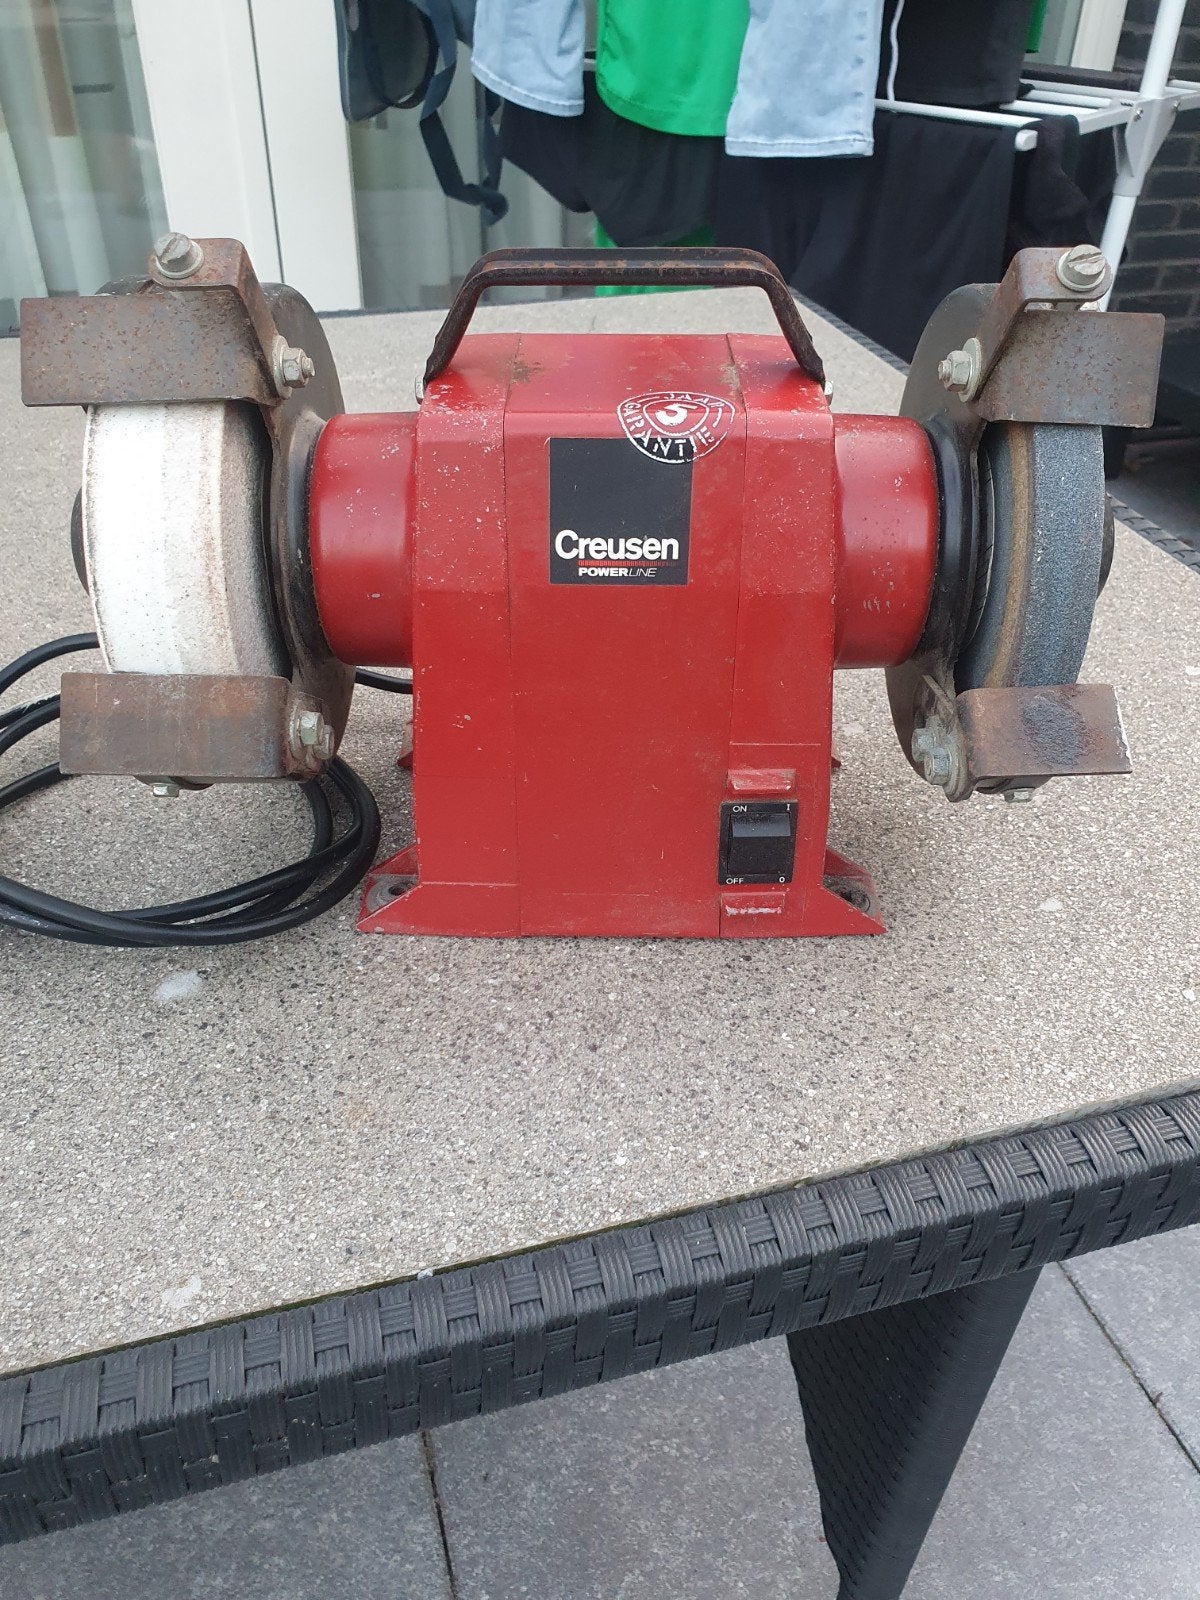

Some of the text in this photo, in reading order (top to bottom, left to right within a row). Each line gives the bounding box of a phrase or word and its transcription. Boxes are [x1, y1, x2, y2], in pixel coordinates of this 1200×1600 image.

[655, 402, 698, 427] 5
[554, 528, 680, 560] Creusen
[578, 567, 658, 578] POWERLINE
[732, 805, 748, 813] ON
[725, 877, 744, 885] OFF
